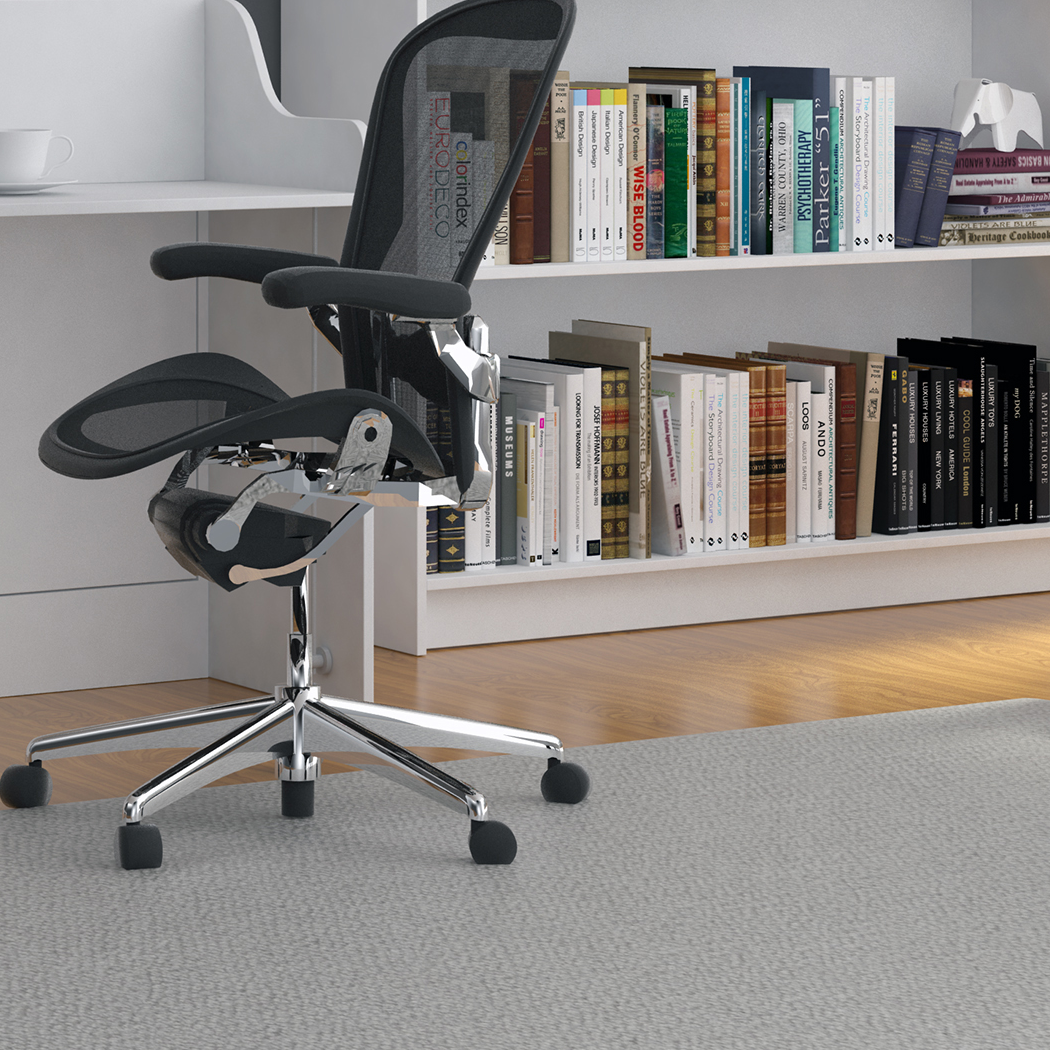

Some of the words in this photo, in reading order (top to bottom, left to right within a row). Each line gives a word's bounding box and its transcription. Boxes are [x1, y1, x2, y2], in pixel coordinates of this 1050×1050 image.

[778, 121, 786, 145] OHIO
[435, 98, 450, 238] EURODECO
[778, 149, 787, 193] COUNTY,
[797, 130, 811, 221] PSYCHOTHERAPY
[992, 157, 1016, 167] SAFETY
[1018, 156, 1042, 166] BASICS
[456, 141, 471, 228] colorindex
[633, 166, 644, 201] WISE
[814, 162, 829, 245] Parker
[633, 205, 644, 251] BLOOD
[968, 233, 1006, 242] Heritage
[1013, 388, 1019, 398] my
[505, 416, 513, 478] MUSEUMS
[817, 420, 826, 457] ANDO
